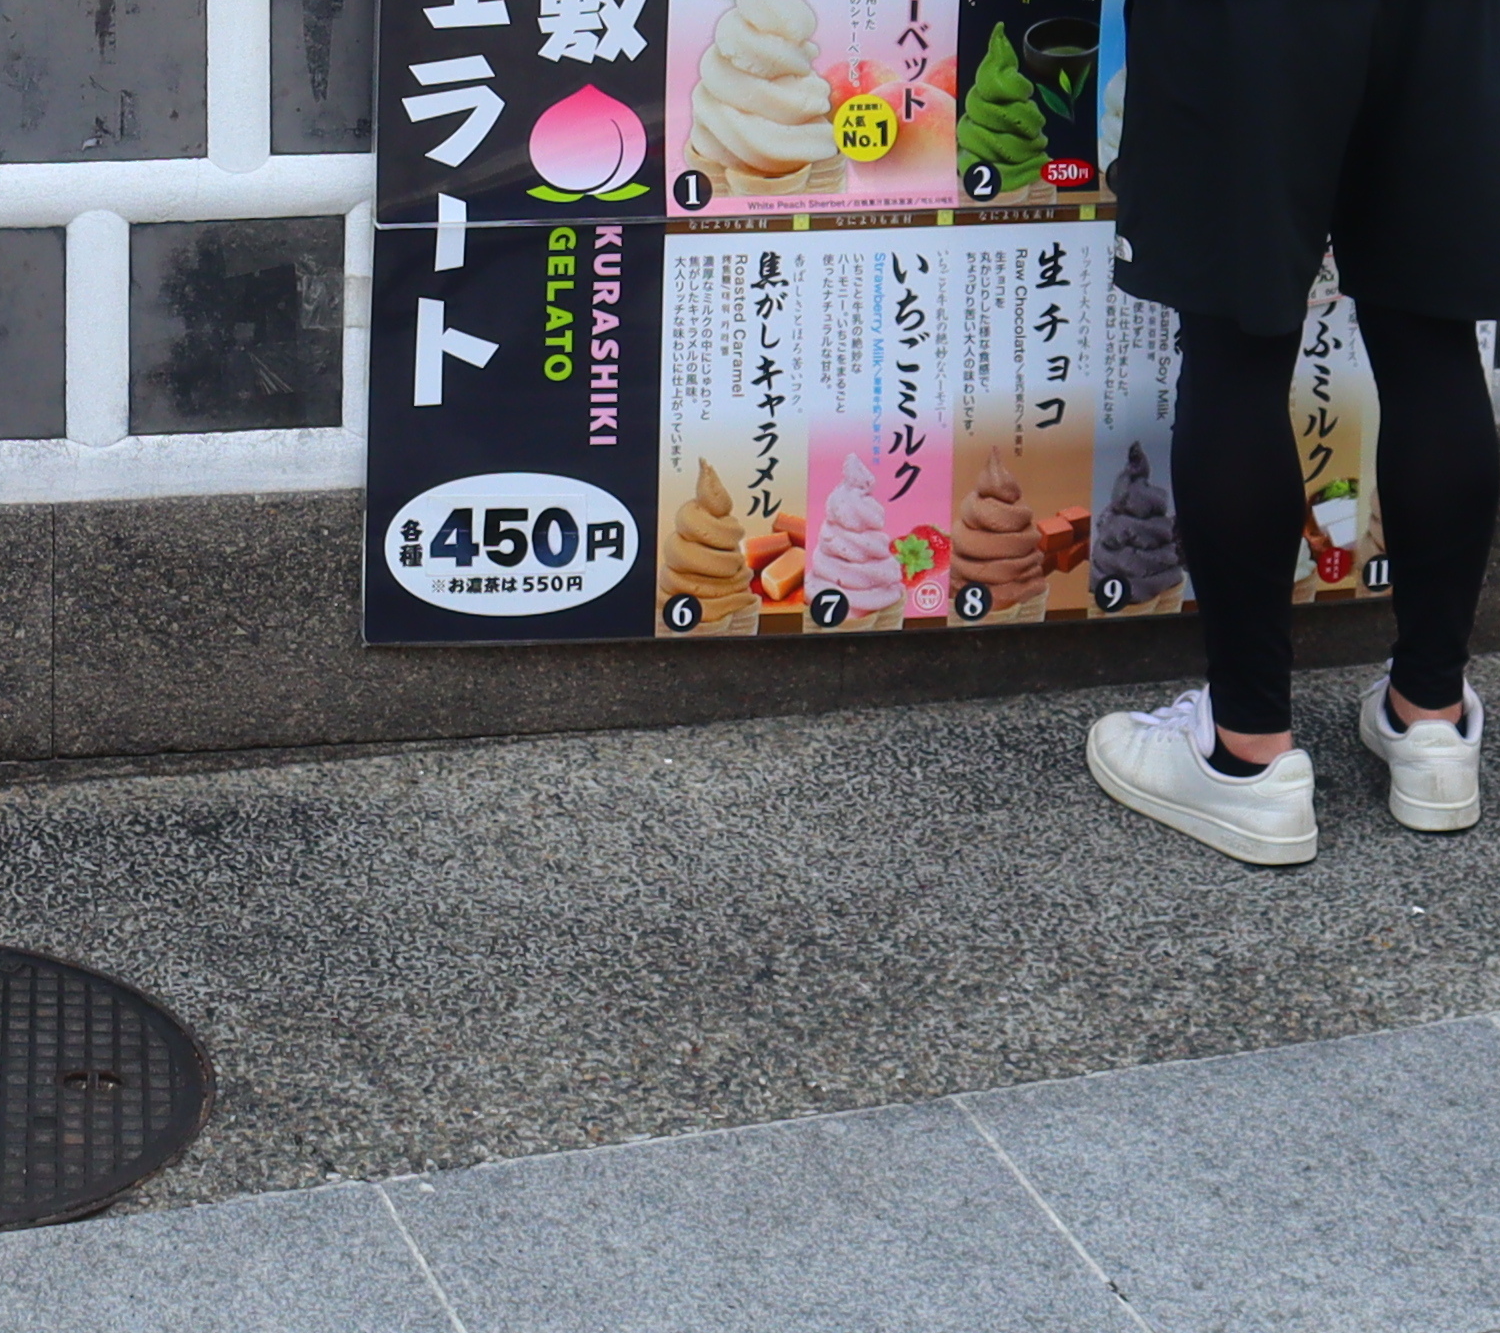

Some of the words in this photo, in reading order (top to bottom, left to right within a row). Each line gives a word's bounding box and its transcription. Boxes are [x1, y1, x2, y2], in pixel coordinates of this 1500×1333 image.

[842, 118, 889, 149] No.1
[972, 165, 994, 196] 2
[1047, 163, 1089, 181] 550円
[747, 199, 775, 211] White
[776, 198, 806, 210] Peach
[1014, 248, 1029, 281] Raw
[543, 225, 578, 383] GELATO
[732, 254, 748, 324] Roasted
[870, 251, 887, 335] Strawberry
[588, 224, 625, 447] KURASHIKI
[1033, 241, 1071, 430] 生チョコ
[730, 328, 747, 399] Caramel
[887, 251, 932, 503] いちごミルク
[1156, 355, 1172, 384] Soy
[746, 250, 790, 519] 焦がしキャラメル
[1156, 389, 1170, 422] Milk
[398, 518, 425, 570] 各種
[428, 505, 626, 570] 450円
[1367, 558, 1391, 588] 11
[821, 593, 842, 624] 7
[964, 586, 985, 618] 8
[1106, 578, 1124, 609] 9
[671, 597, 693, 628] 6
